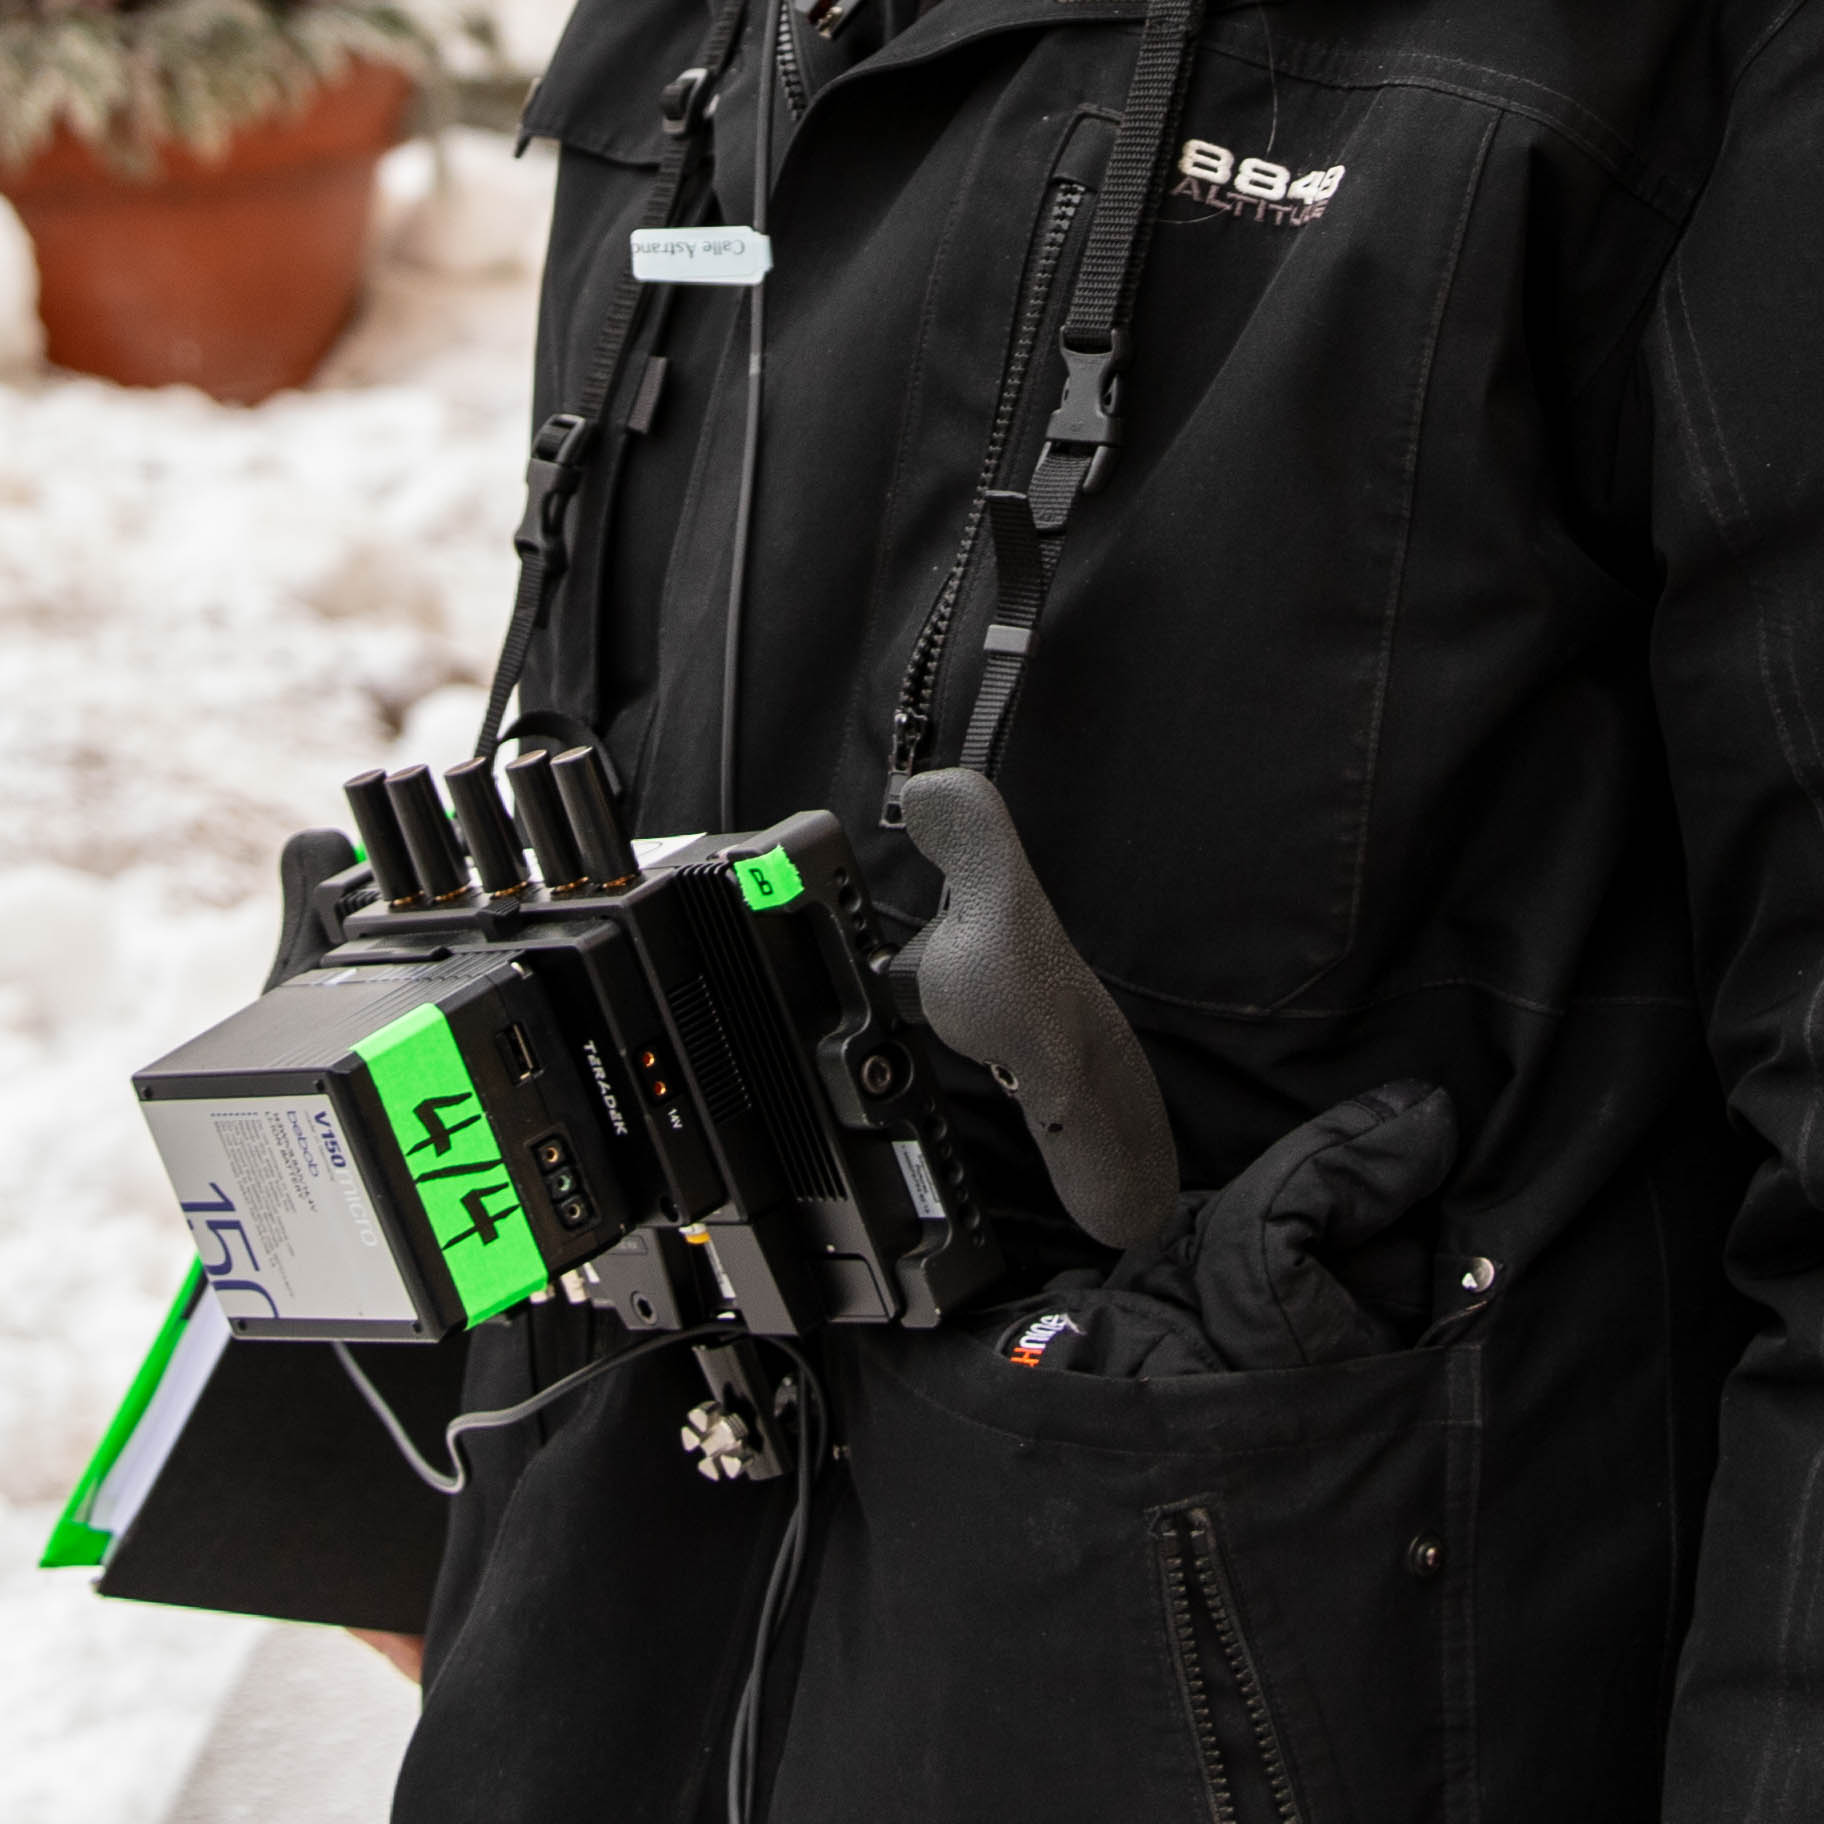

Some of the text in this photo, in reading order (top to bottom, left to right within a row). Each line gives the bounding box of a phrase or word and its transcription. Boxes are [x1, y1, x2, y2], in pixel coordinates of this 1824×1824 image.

[1178, 138, 1346, 205] 8848
[702, 239, 746, 257] Calle
[583, 1039, 628, 1135] TERADEK
[286, 1110, 320, 1178] bebob
[406, 1091, 521, 1251] 4/4
